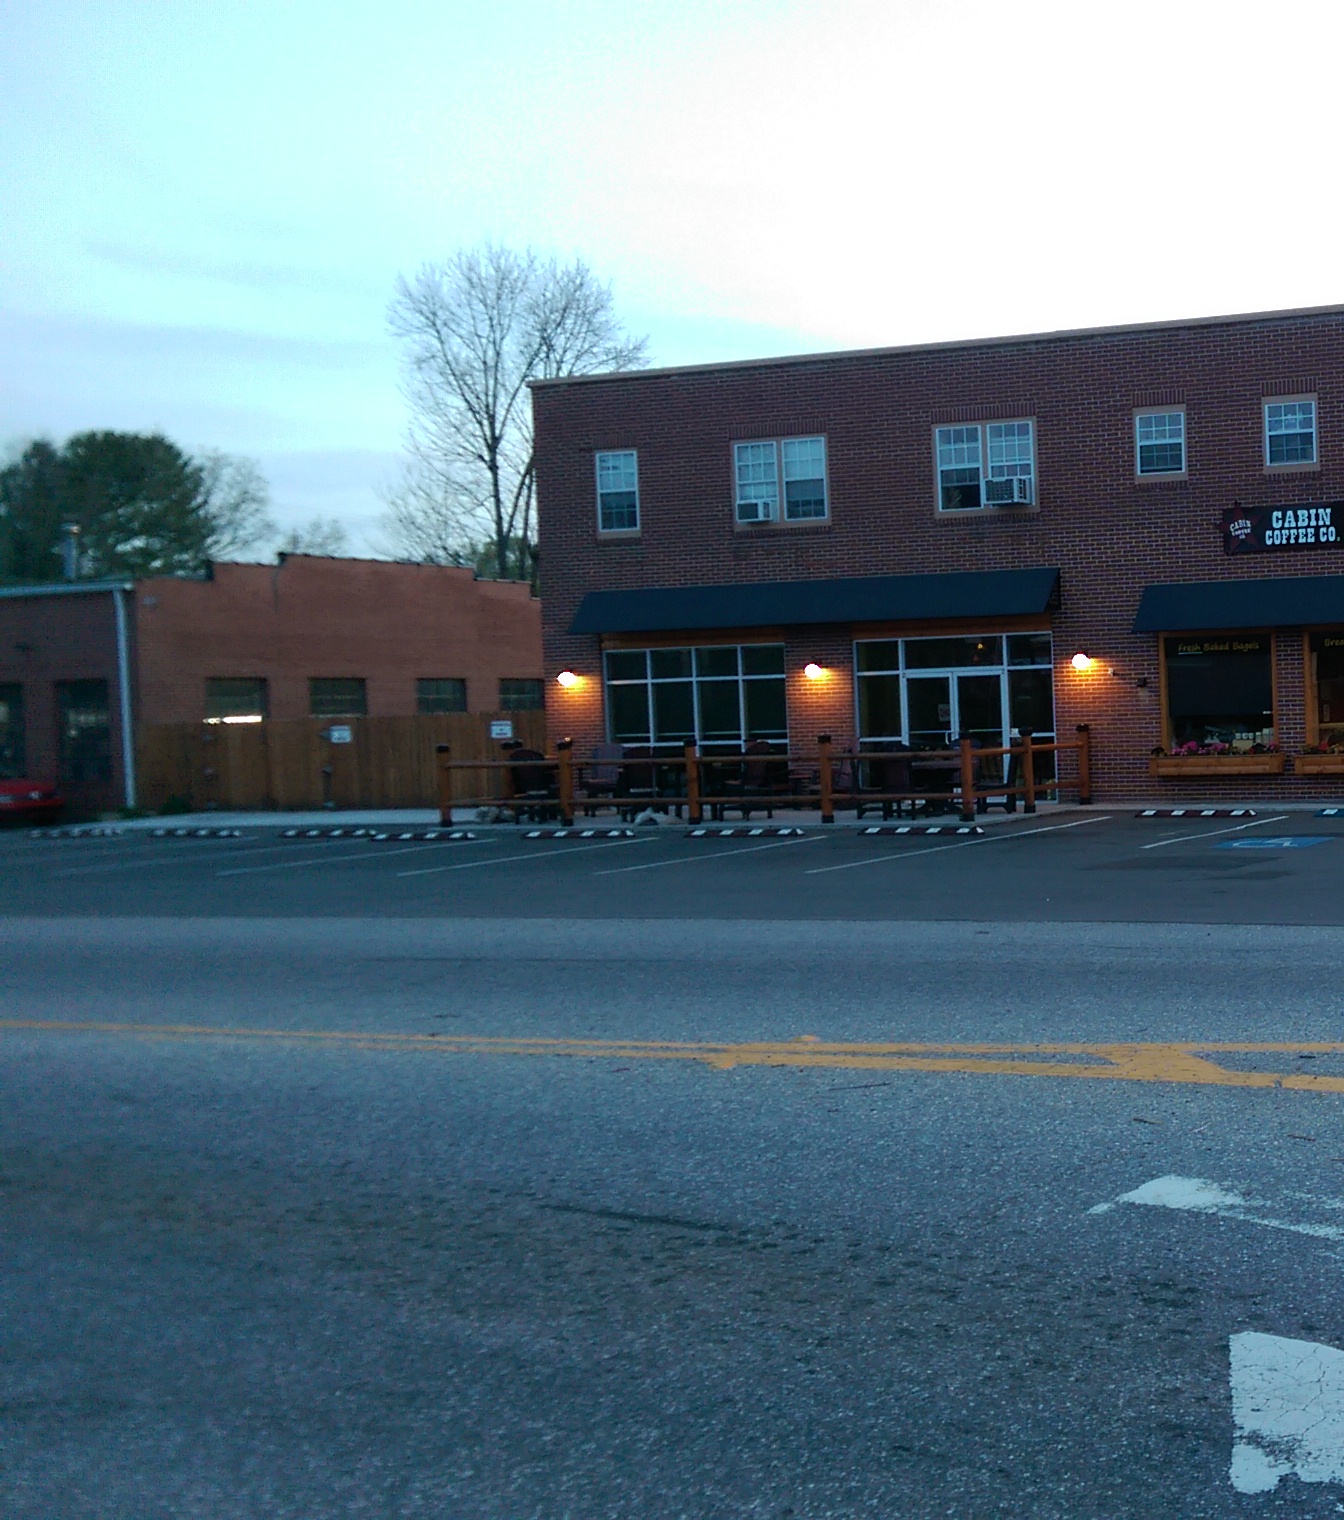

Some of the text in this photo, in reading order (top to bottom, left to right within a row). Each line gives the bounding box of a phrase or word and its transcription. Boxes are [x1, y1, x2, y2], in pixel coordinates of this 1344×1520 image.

[1272, 508, 1332, 528] CABIN
[1265, 526, 1340, 545] COFFEE CO.
[1178, 641, 1260, 652] Fresh Baked Bagels
